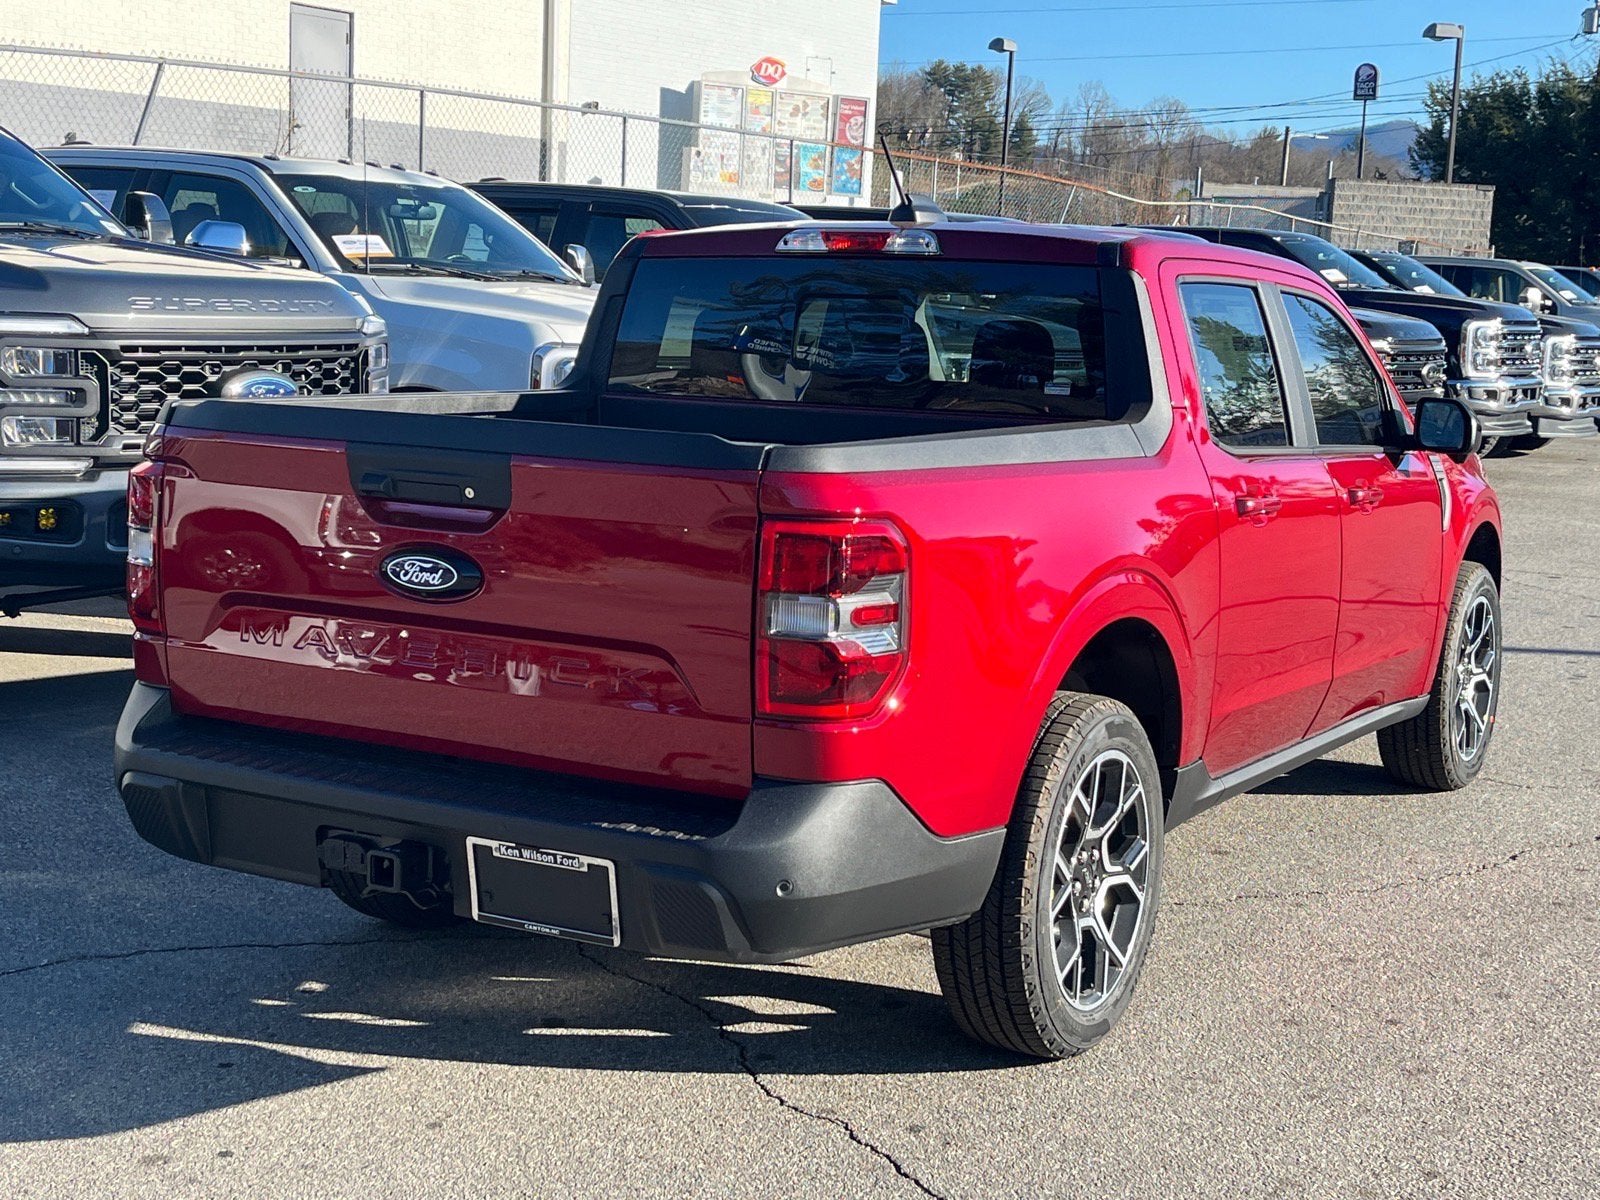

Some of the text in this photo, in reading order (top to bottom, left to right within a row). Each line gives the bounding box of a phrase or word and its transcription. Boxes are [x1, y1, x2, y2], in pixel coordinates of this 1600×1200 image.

[760, 62, 783, 80] DQ
[128, 296, 335, 313] SUPER DUTY
[400, 560, 444, 585] Ford
[240, 618, 654, 699] MAVERICK
[500, 845, 579, 868] Ken Wilson Ford
